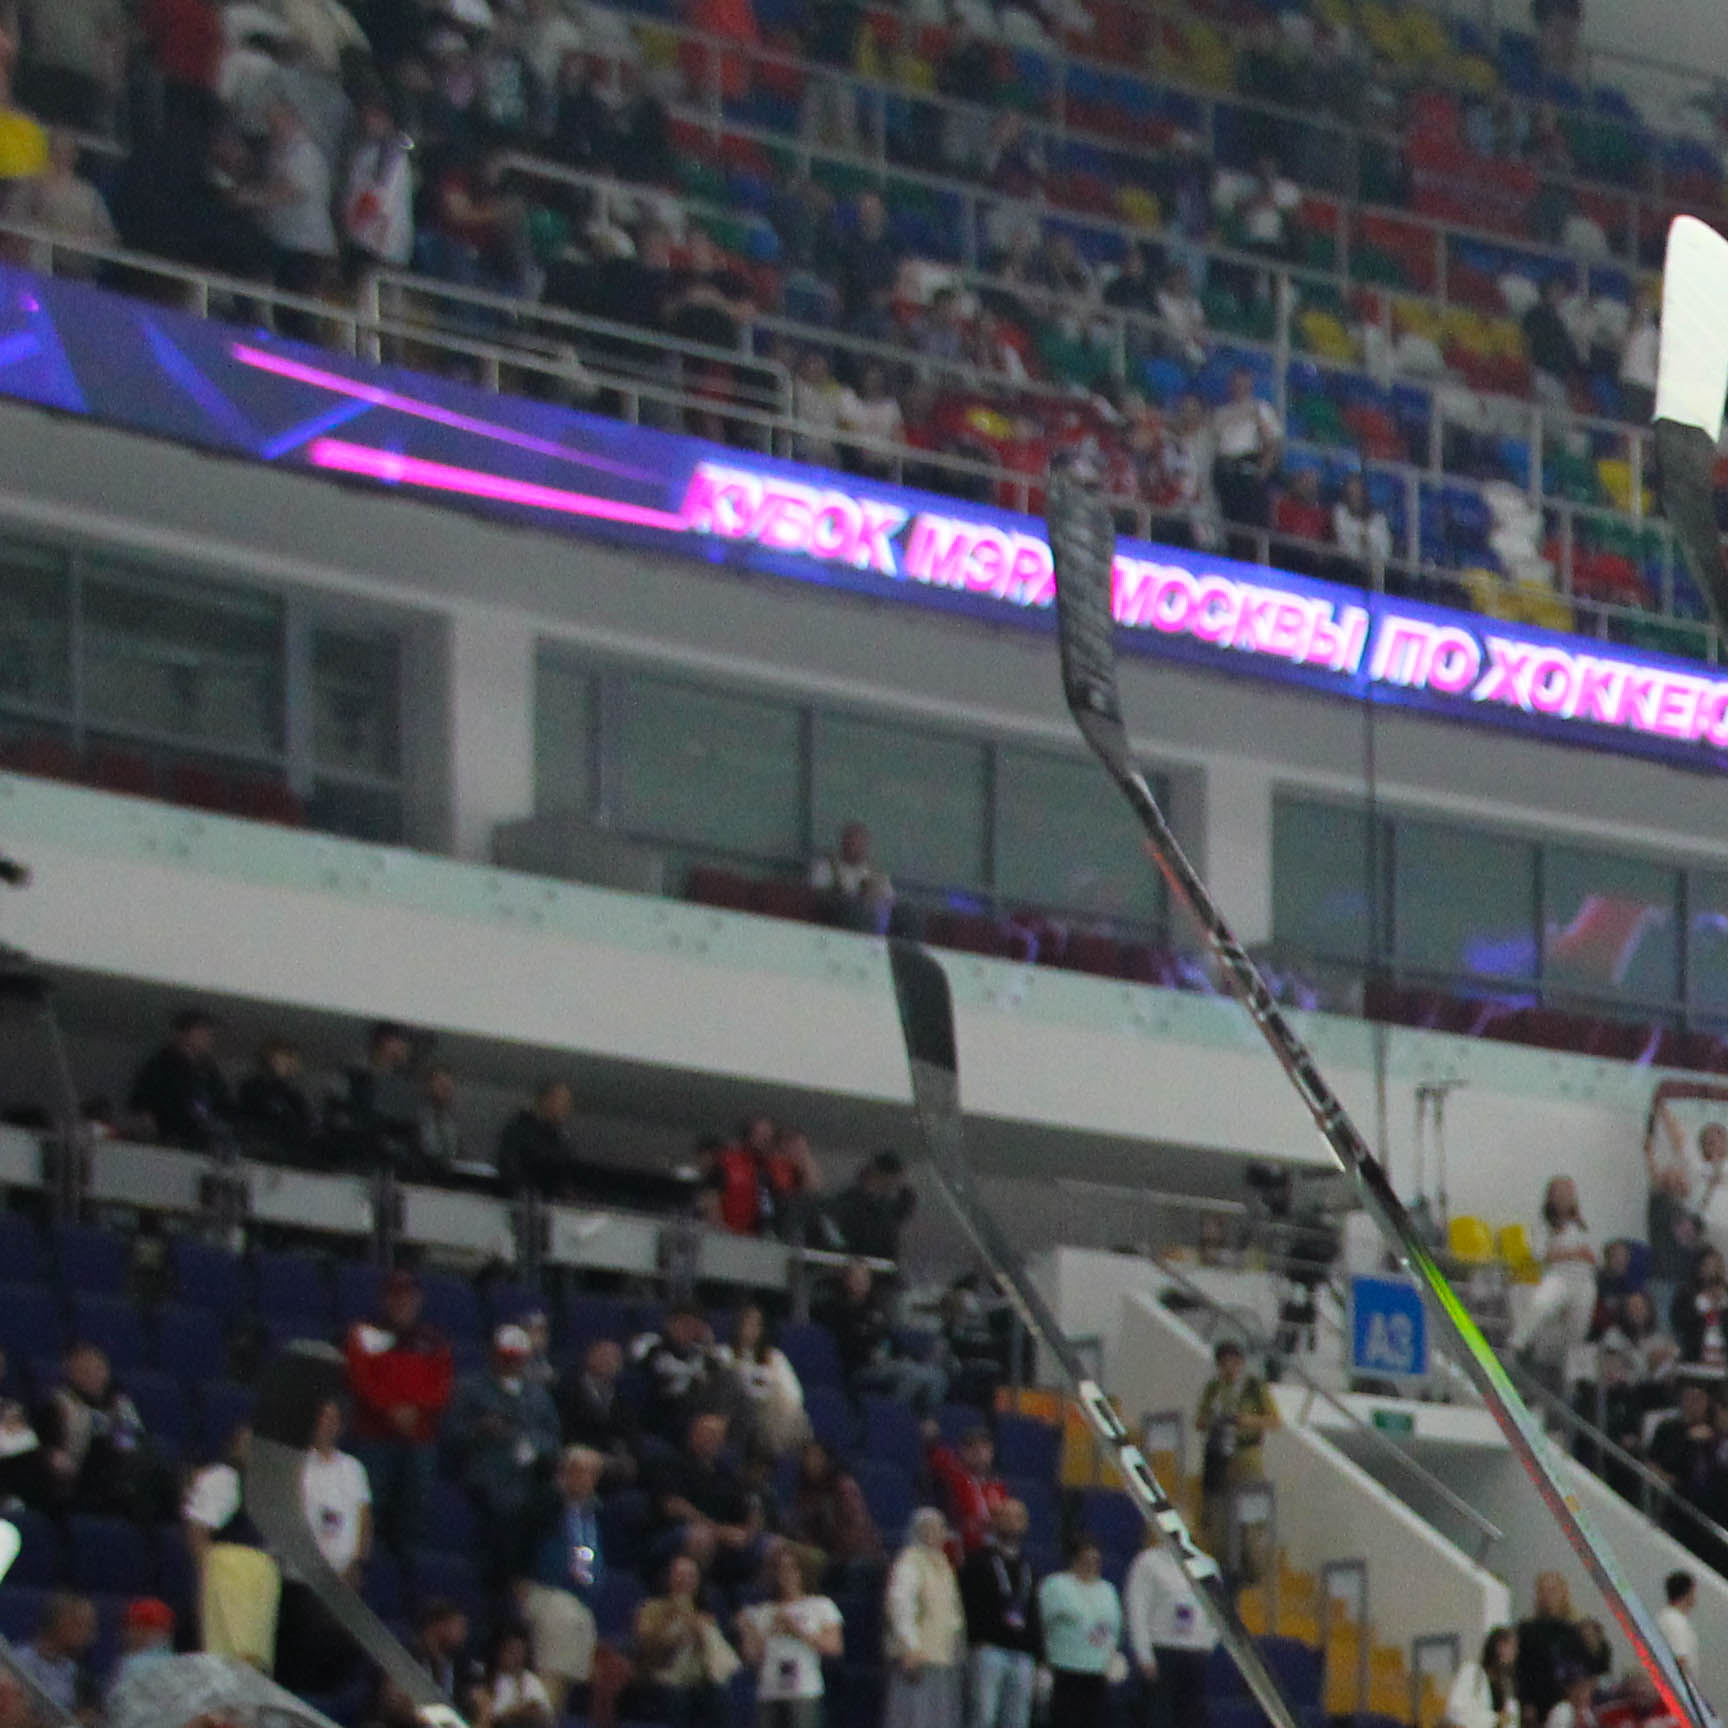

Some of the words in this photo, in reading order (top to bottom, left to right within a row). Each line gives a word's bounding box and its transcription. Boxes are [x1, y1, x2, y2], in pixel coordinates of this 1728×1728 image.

[1113, 554, 1370, 675] МОСКВЫ
[1371, 615, 1482, 698] ПО
[1077, 1377, 1222, 1584] CCM
